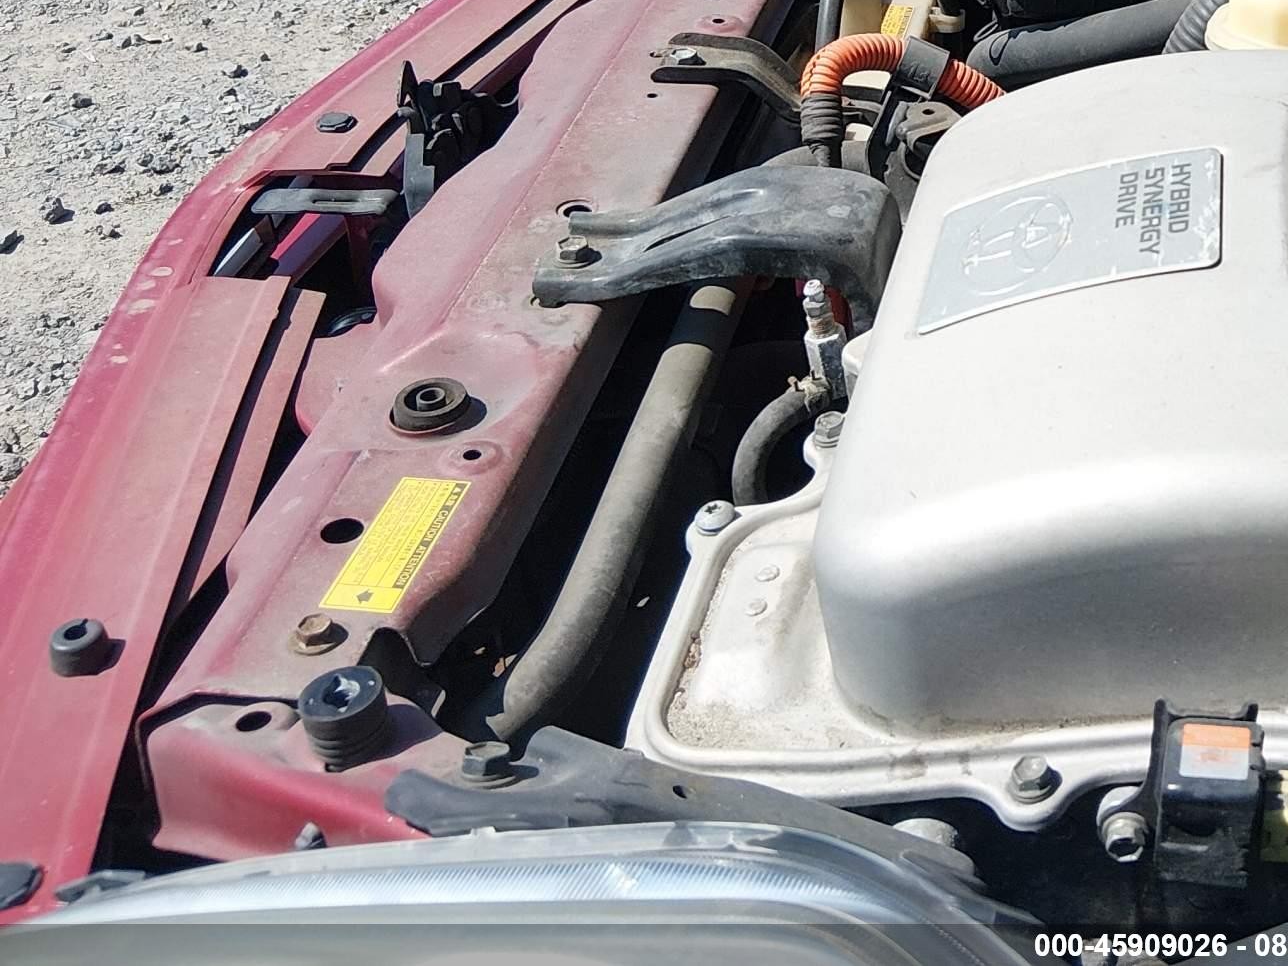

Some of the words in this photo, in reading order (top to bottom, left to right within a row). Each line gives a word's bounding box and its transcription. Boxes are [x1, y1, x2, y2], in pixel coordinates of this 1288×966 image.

[1115, 171, 1139, 228] DRIVE
[1139, 167, 1165, 254] SYNERGY
[1168, 163, 1192, 233] HYBRID
[426, 510, 449, 542] CAUTION
[396, 546, 427, 586] ATTENTION
